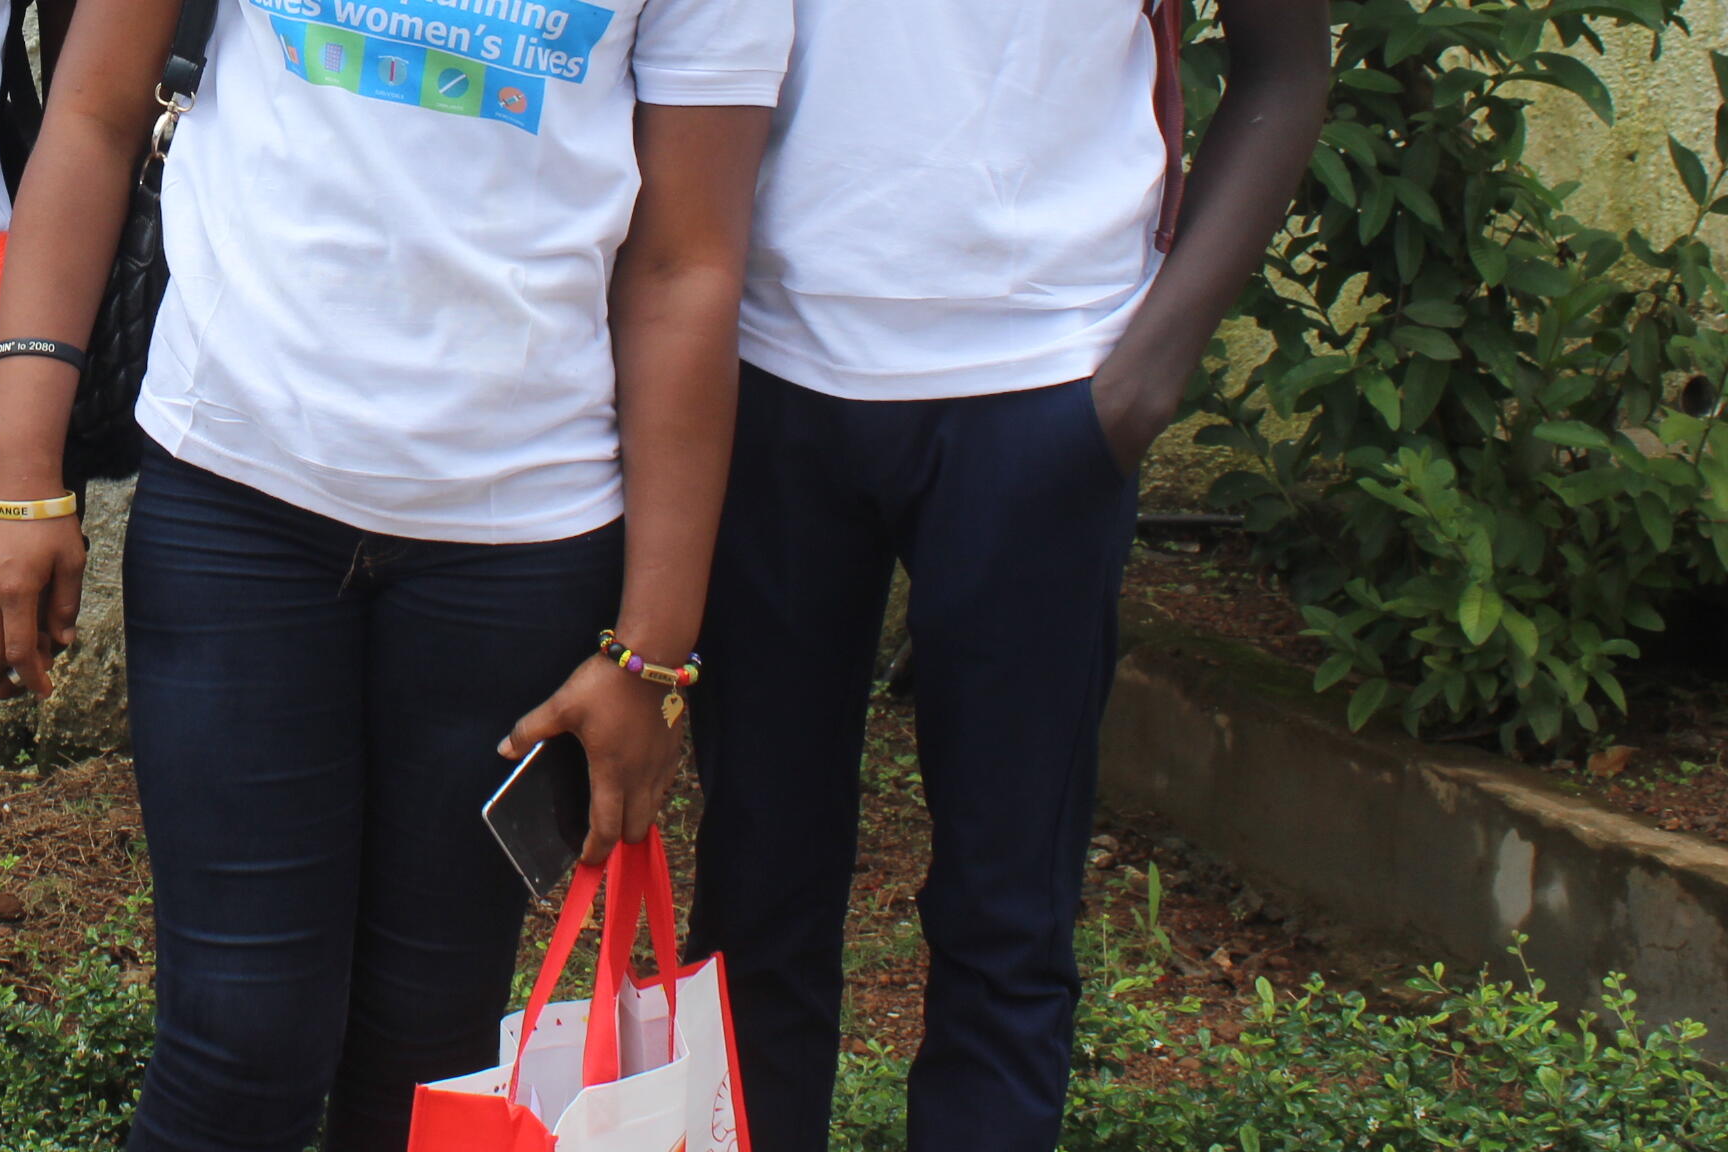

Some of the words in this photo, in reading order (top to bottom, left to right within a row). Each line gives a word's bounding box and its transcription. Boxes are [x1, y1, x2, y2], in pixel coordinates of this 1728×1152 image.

[514, 34, 584, 84] lives
[17, 341, 27, 351] to
[29, 341, 55, 353] 2080
